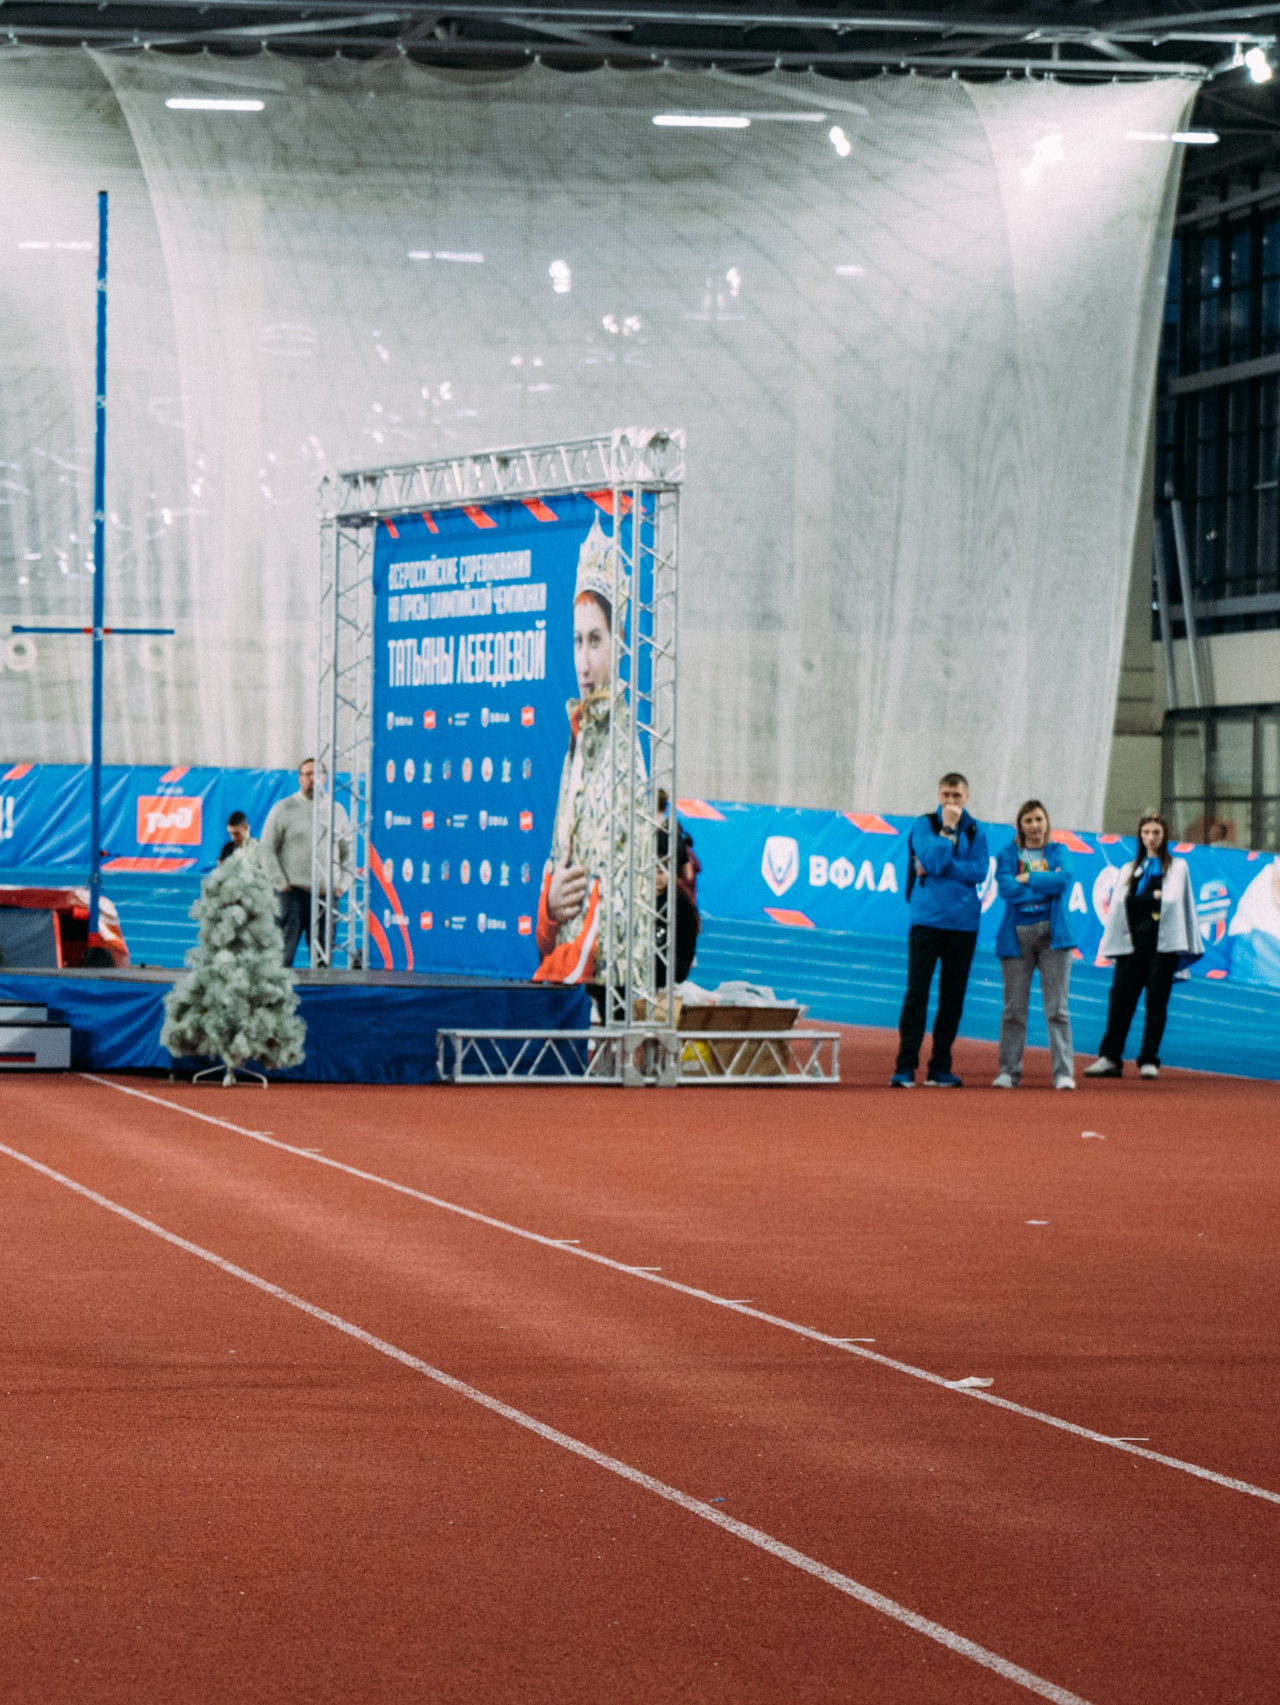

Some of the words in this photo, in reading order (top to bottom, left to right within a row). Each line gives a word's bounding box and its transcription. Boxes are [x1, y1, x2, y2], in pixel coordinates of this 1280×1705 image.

[387, 635, 455, 688] ТАТЬЯНЫ
[456, 619, 547, 688] ЛЕБЕДЕВОЙ
[809, 854, 899, 894] ВФЛА
